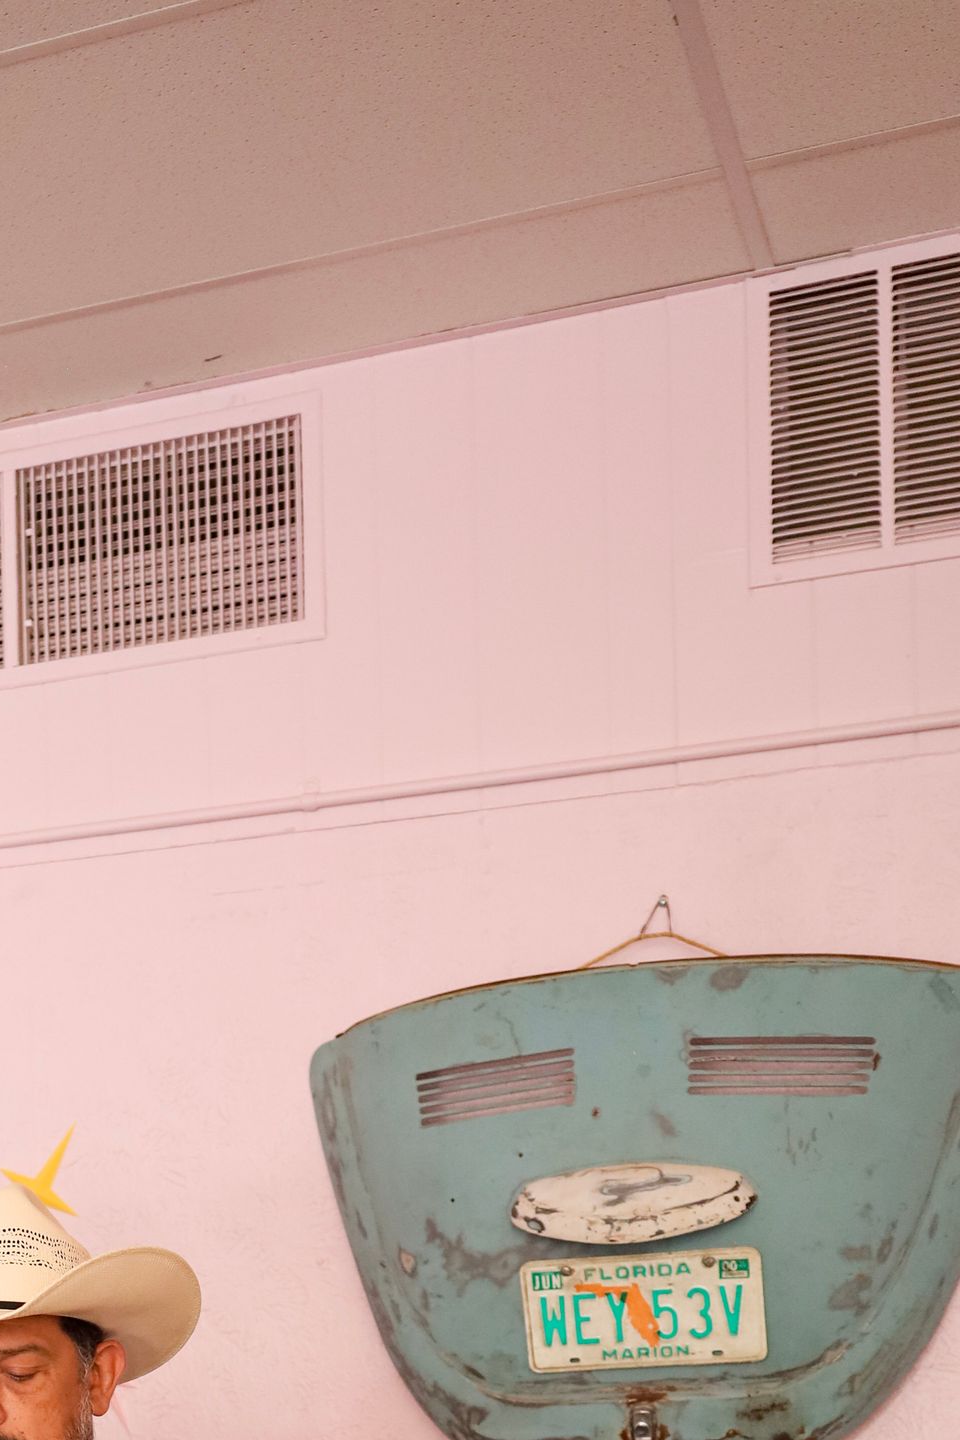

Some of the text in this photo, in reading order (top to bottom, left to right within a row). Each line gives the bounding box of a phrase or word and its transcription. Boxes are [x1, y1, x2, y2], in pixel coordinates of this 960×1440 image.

[583, 1262, 691, 1281] FLORIDA
[533, 1274, 561, 1290] JUN
[541, 1284, 743, 1347] WEY 53V
[602, 1344, 689, 1361] MARION
